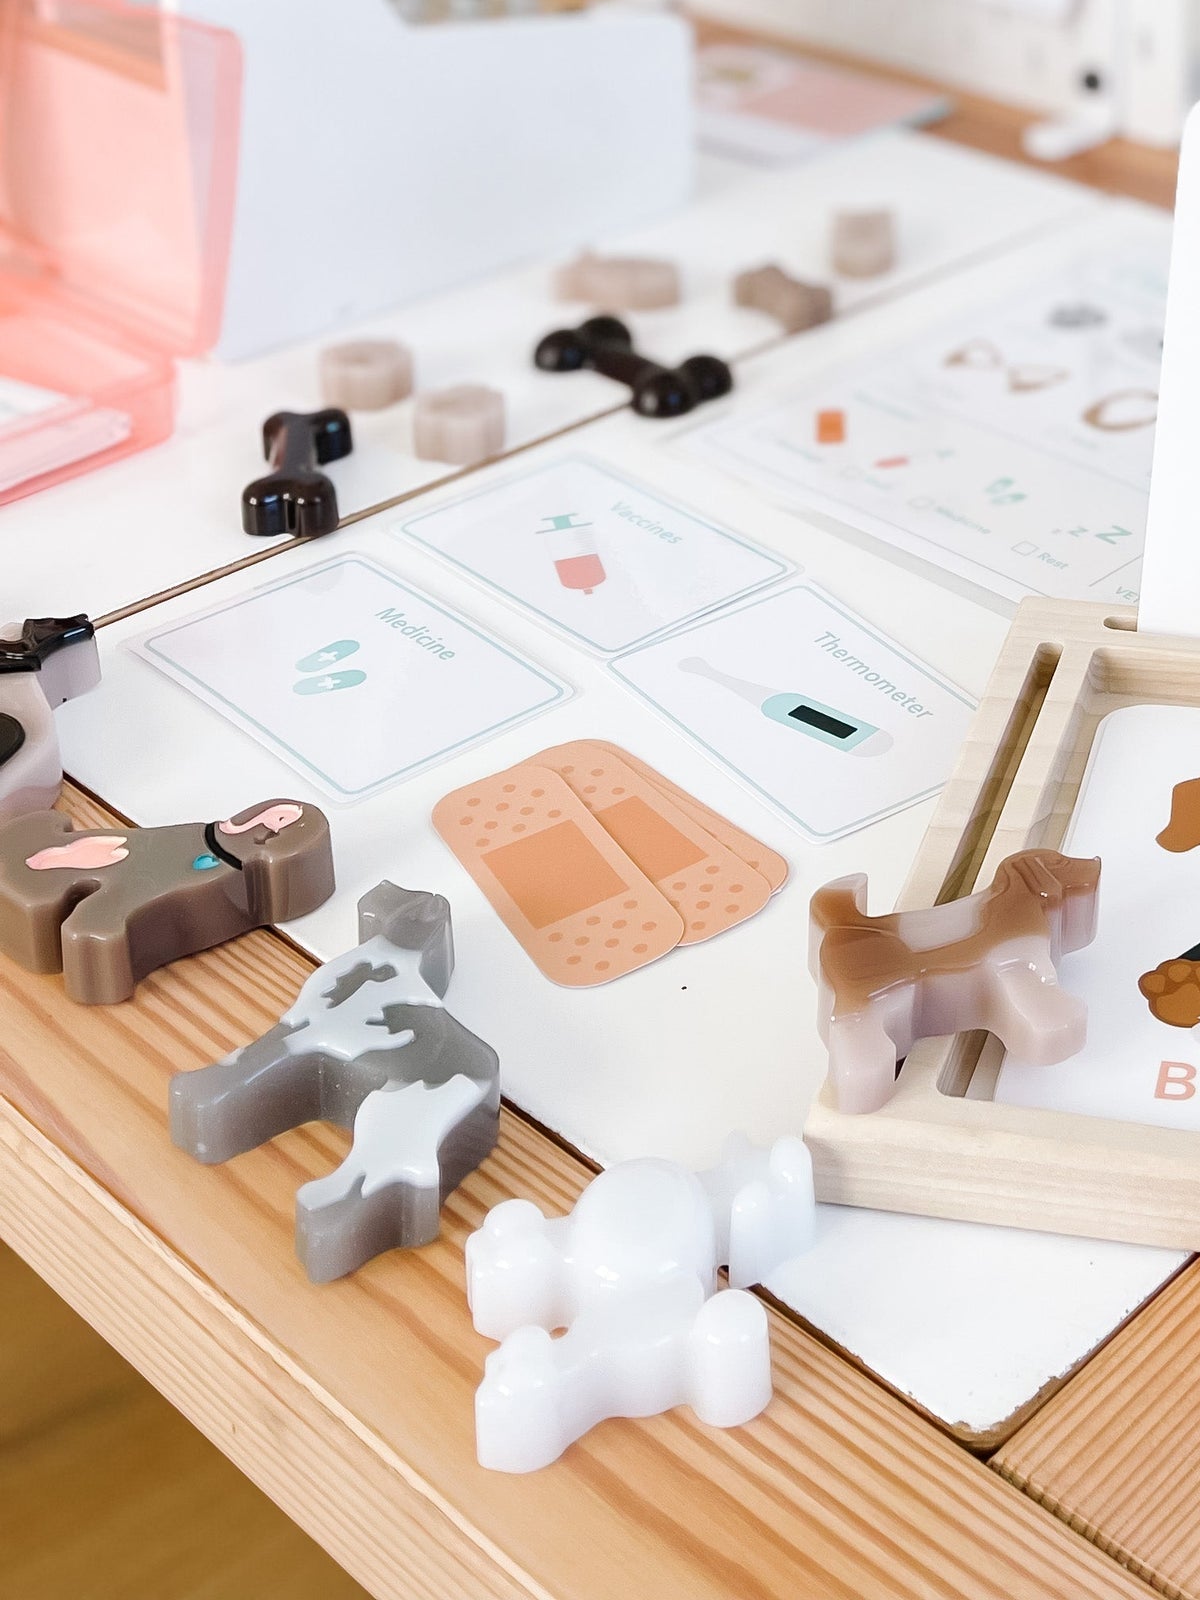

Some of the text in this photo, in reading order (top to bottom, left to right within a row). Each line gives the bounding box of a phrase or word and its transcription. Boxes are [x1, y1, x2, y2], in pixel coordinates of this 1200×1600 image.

[608, 499, 684, 546] Vaccines
[1037, 551, 1070, 570] Rest
[375, 606, 456, 662] Medicine
[812, 631, 935, 721] Thermometer
